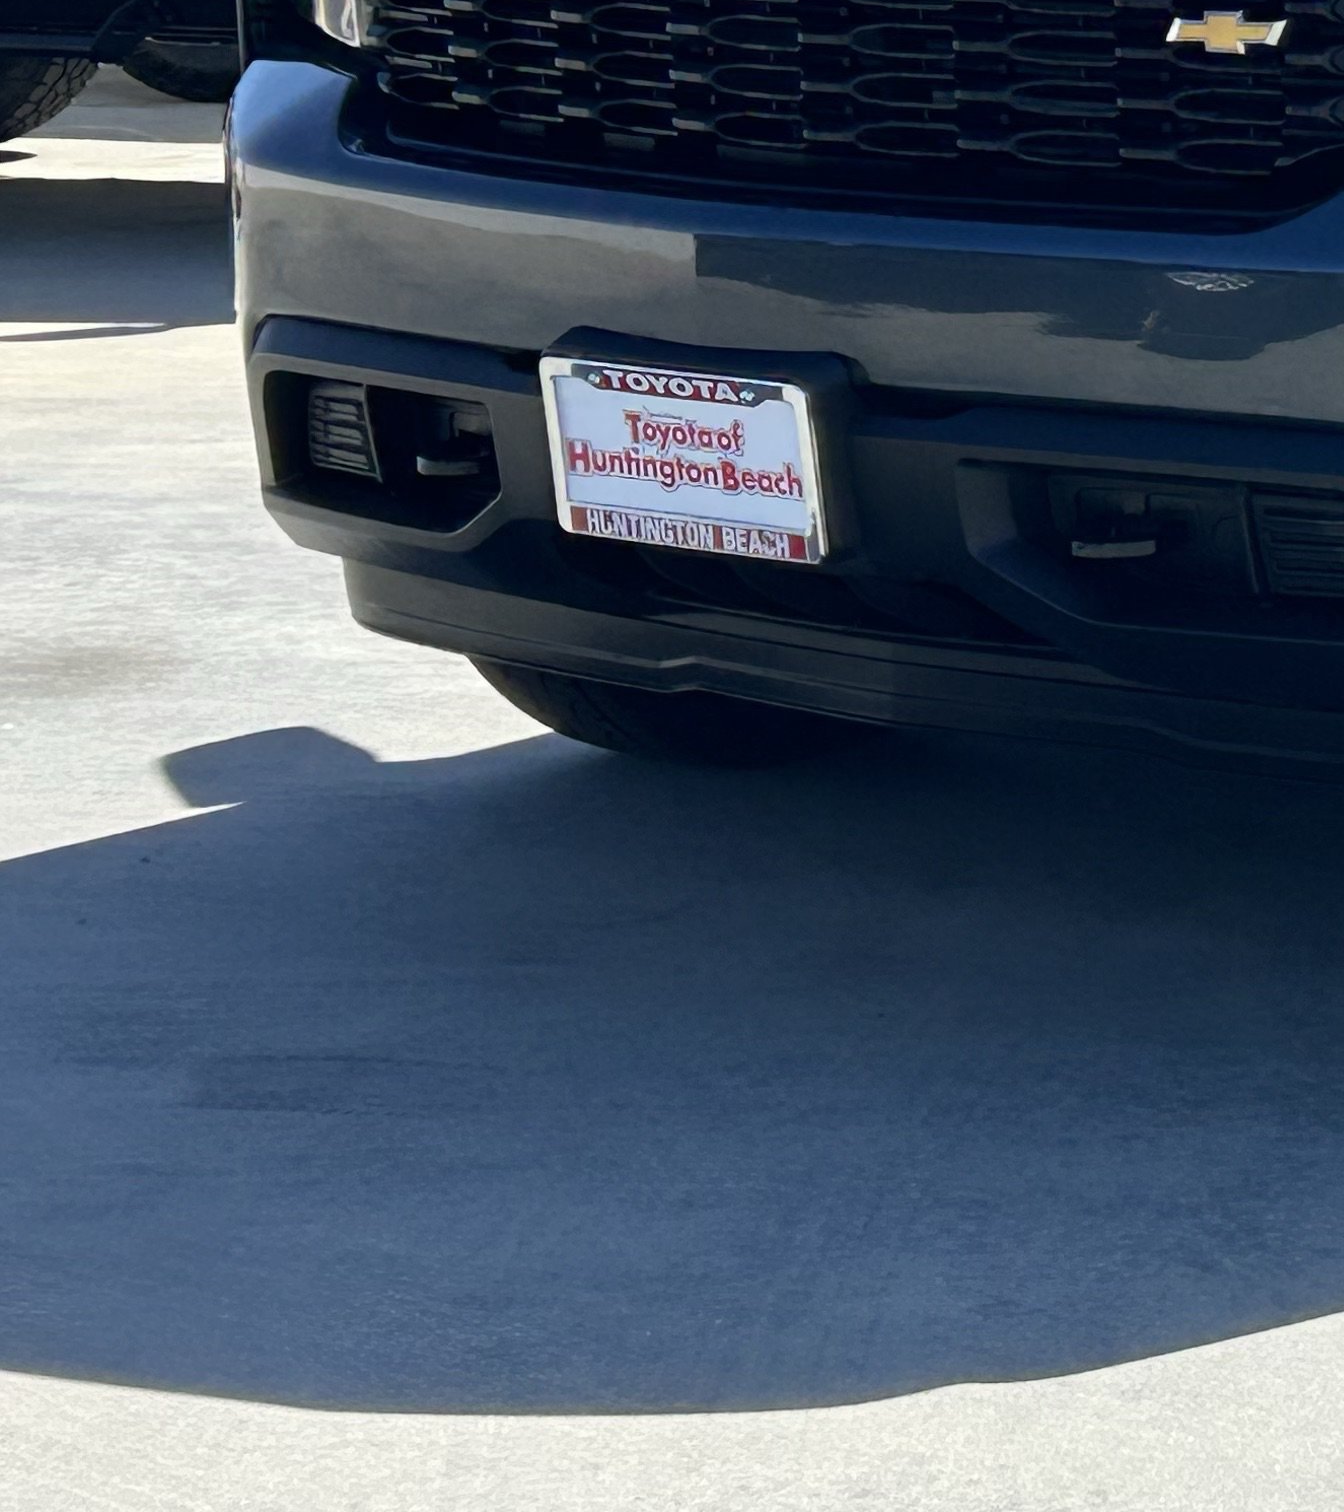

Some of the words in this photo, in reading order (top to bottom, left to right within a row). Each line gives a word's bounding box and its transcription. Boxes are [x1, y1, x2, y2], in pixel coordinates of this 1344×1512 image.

[602, 368, 740, 403] TOYOTA
[623, 411, 713, 451] Toyota
[716, 419, 744, 454] of
[567, 439, 719, 488] Huntington
[719, 458, 804, 498] Beach
[586, 508, 714, 551] HUNTINGTON
[721, 526, 791, 558] BEACH
